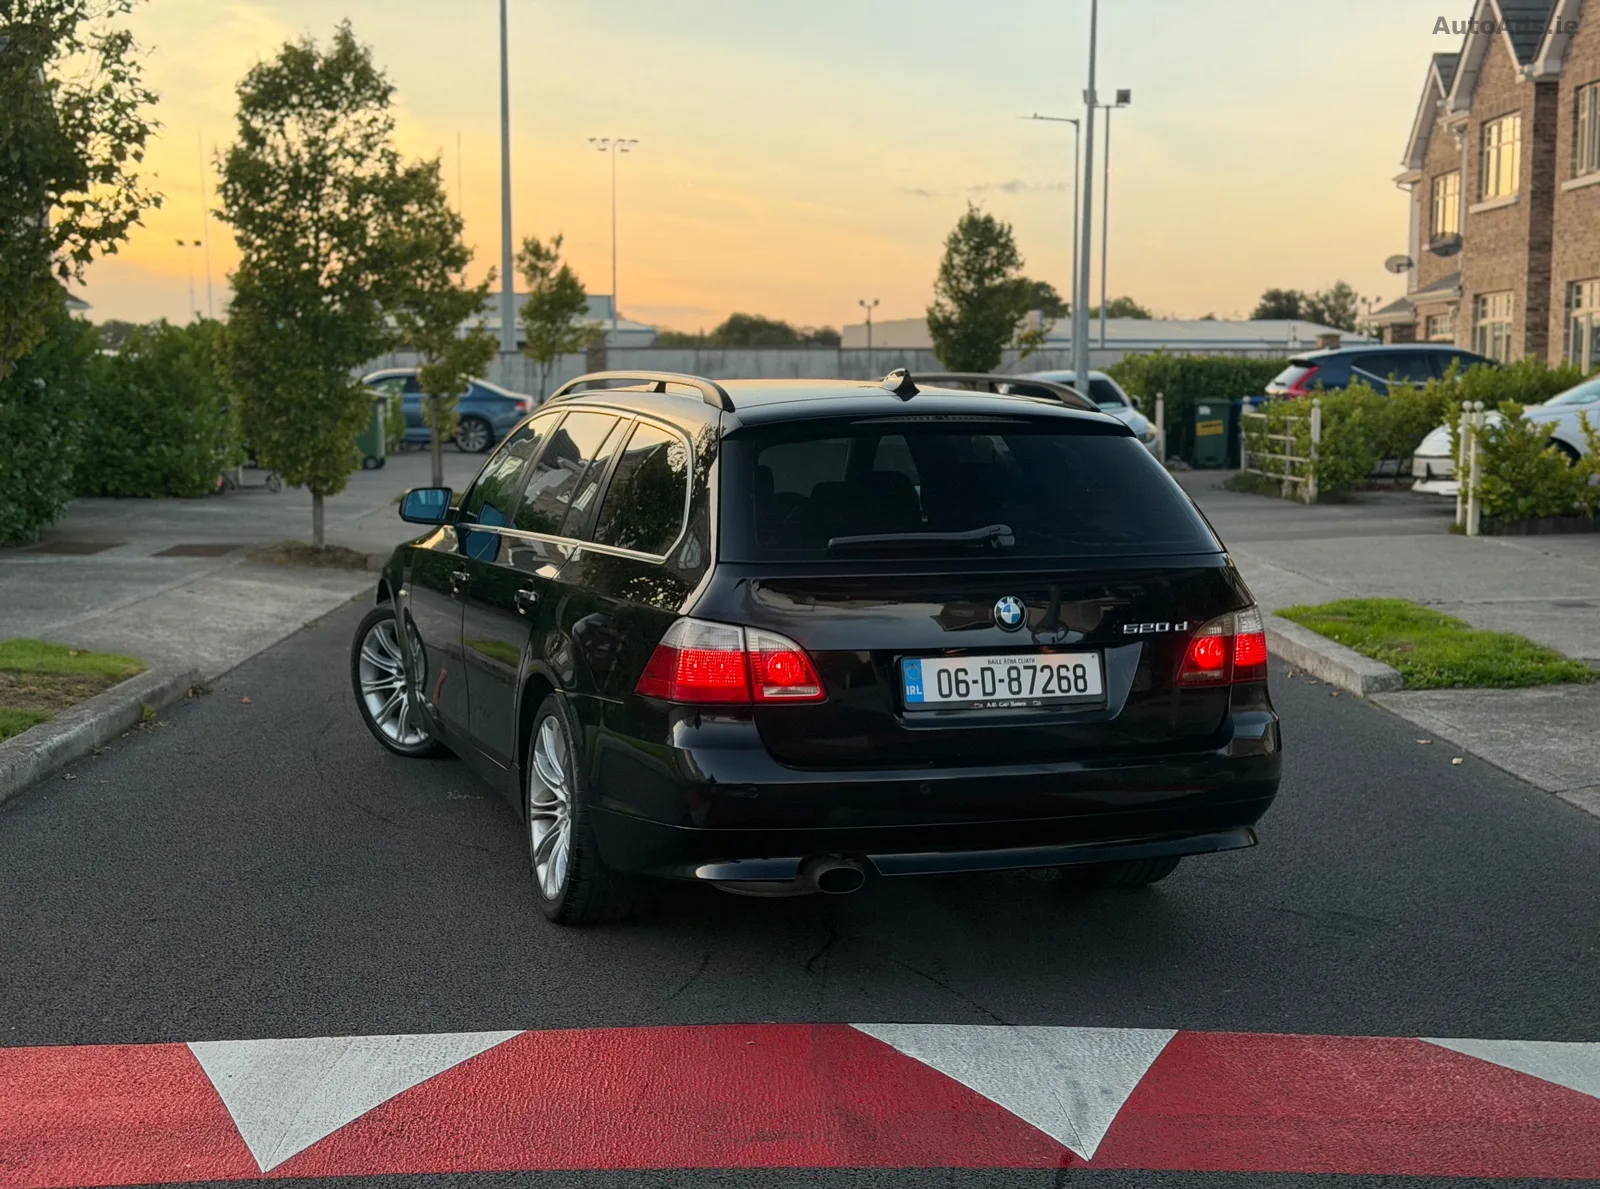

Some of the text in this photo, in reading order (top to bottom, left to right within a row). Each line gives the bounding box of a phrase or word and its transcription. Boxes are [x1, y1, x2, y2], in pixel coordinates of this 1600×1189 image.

[1123, 621, 1188, 634] 520 d
[936, 663, 1088, 699] 06-D-87268
[906, 685, 923, 696] IRL
